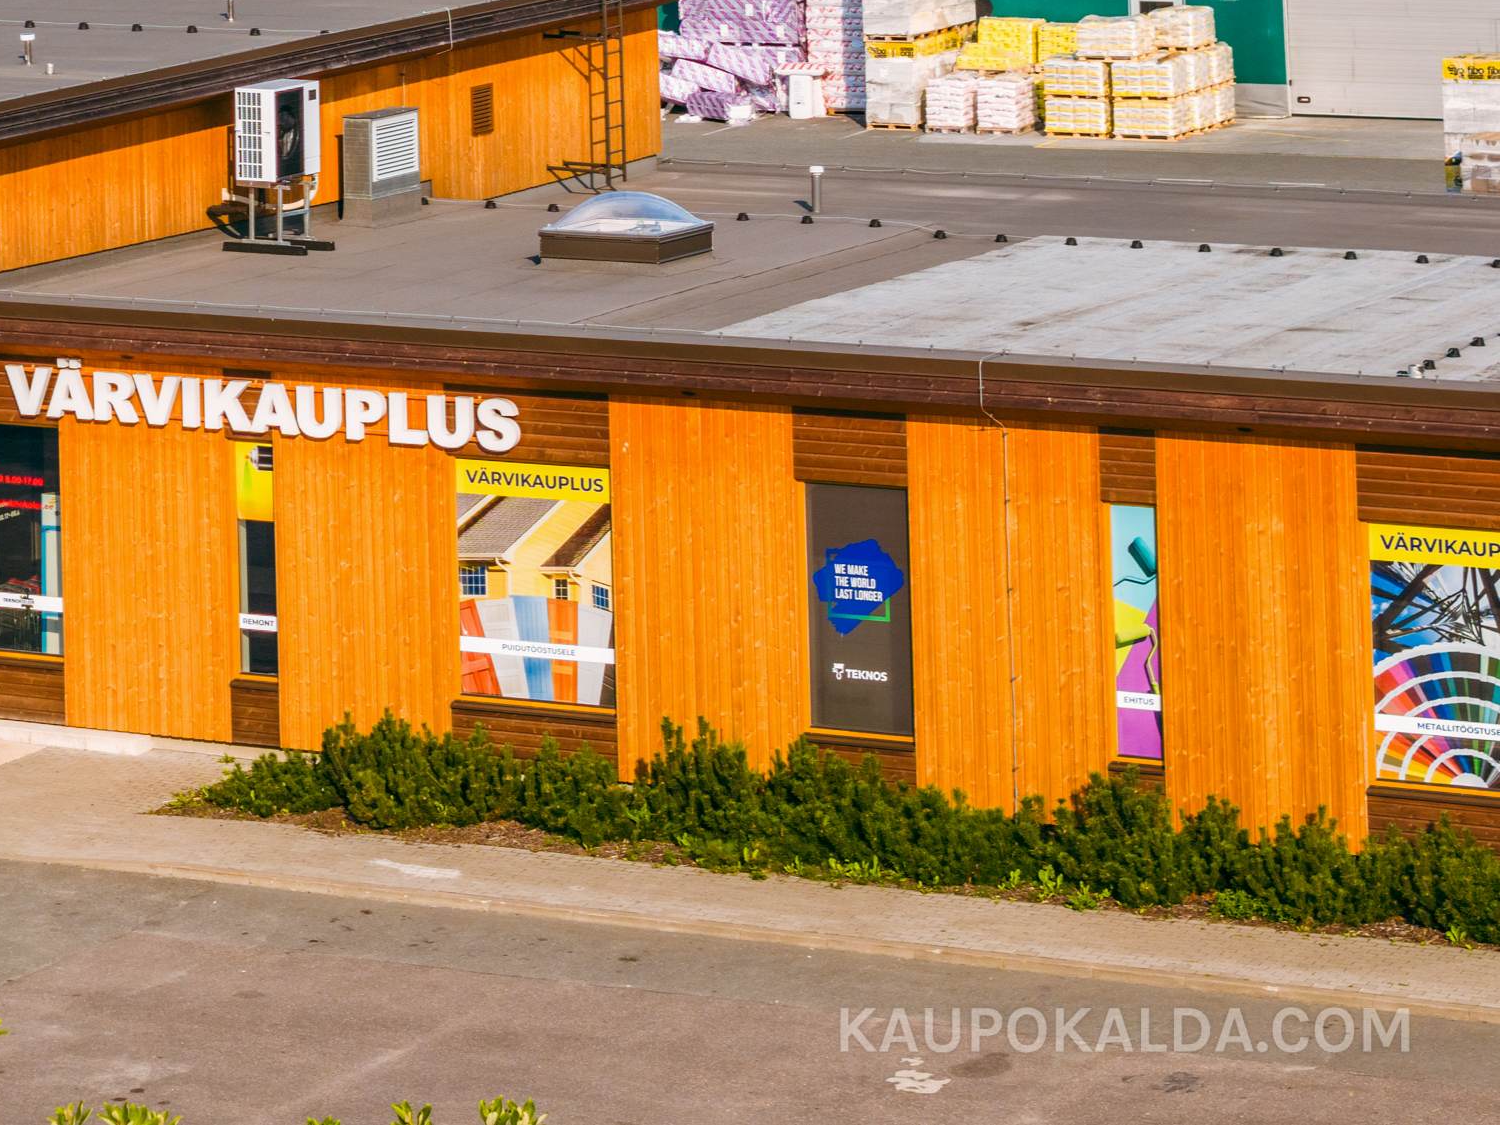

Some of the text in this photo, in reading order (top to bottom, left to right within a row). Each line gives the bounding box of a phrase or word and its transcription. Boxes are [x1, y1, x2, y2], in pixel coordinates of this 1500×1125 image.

[4, 357, 522, 454] VÄRVIKAUPLUS
[466, 467, 604, 493] VÄRVIKAUPLUS
[834, 563, 869, 576] WE MAKE
[834, 576, 876, 589] THE WORLD
[835, 589, 883, 602] LAST LONGER
[242, 617, 275, 627] REMONT
[845, 668, 888, 682] TEKNOS
[1123, 696, 1155, 706] EHITUS
